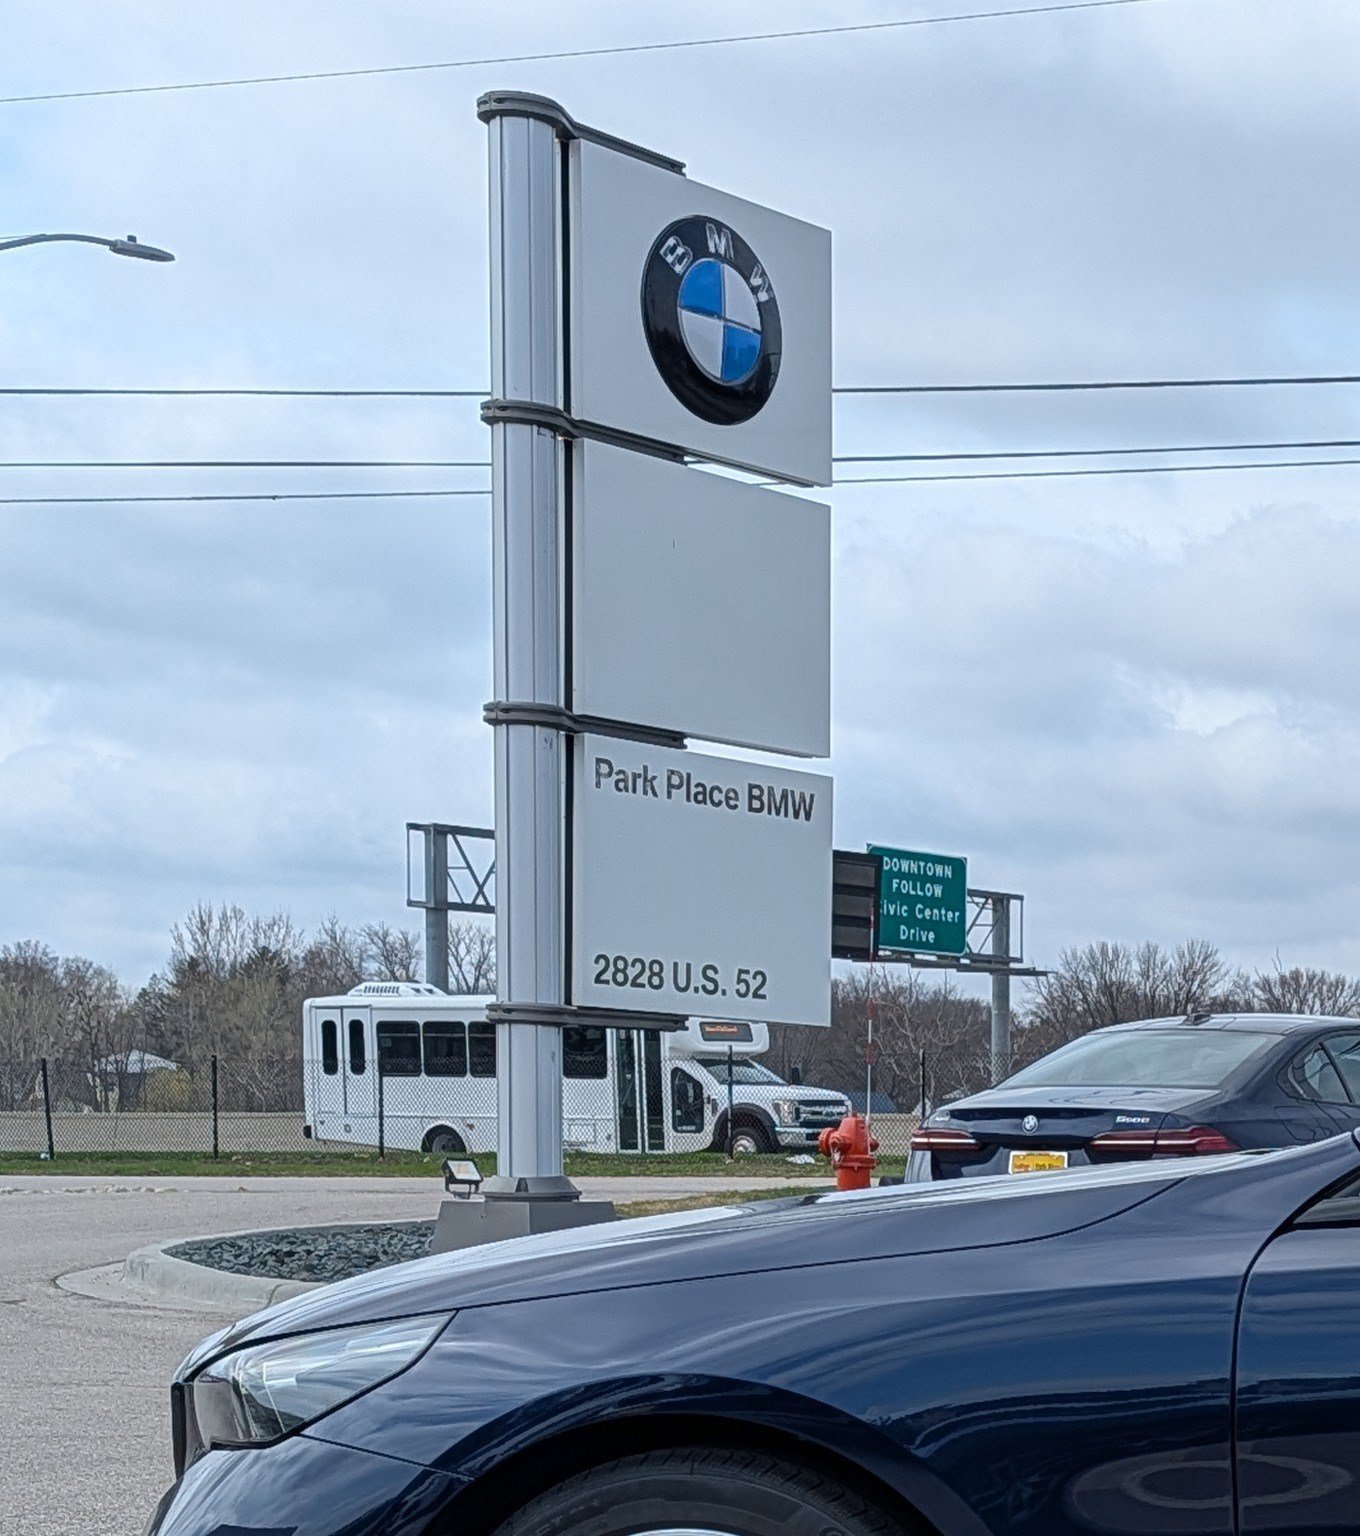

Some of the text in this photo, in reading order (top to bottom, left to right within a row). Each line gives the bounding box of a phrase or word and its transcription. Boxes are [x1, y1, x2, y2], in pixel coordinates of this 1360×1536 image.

[659, 222, 773, 302] BMW
[594, 757, 815, 822] Park Place BMW
[883, 856, 952, 879] DOWNTOWN
[892, 879, 943, 898] FOLLOW
[880, 900, 960, 923] ivic Center
[900, 925, 935, 943] Drive
[594, 954, 767, 1000] 2828 U.S. 52
